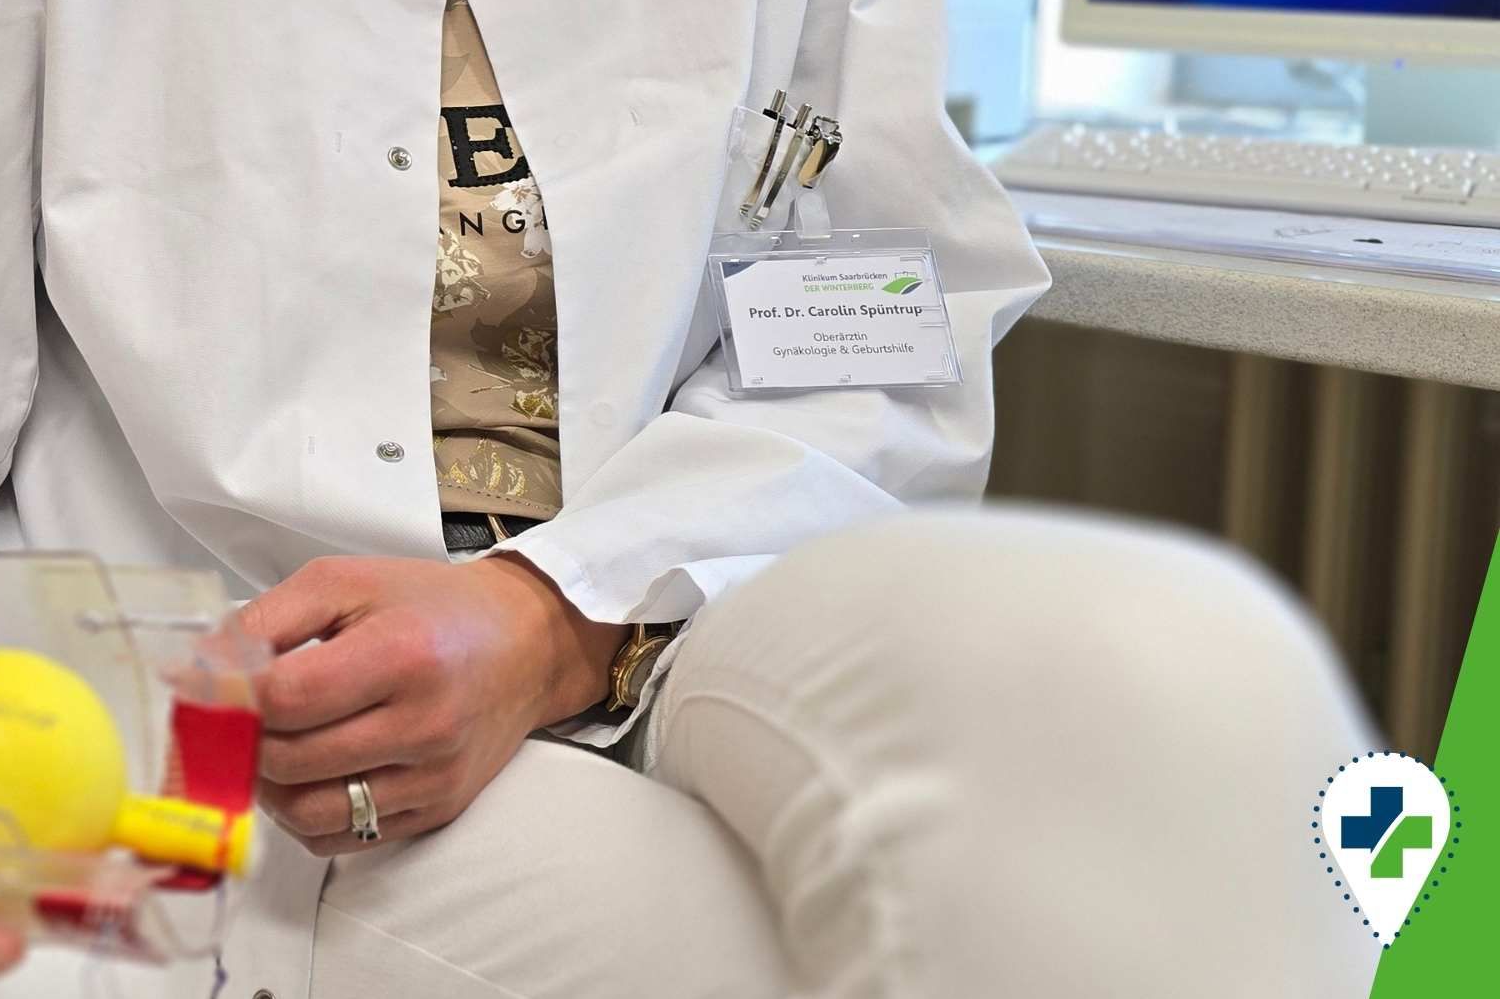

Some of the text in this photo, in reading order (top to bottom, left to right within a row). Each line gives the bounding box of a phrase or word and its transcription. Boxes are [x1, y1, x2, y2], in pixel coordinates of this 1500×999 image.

[802, 270, 888, 282] Klinikum Saarbrücken
[749, 304, 923, 318] Prof. Dr. Carolin Spüntrup
[813, 331, 868, 342] Oberärztin
[772, 343, 915, 358] Gynäkologie & Geburtshilfe
